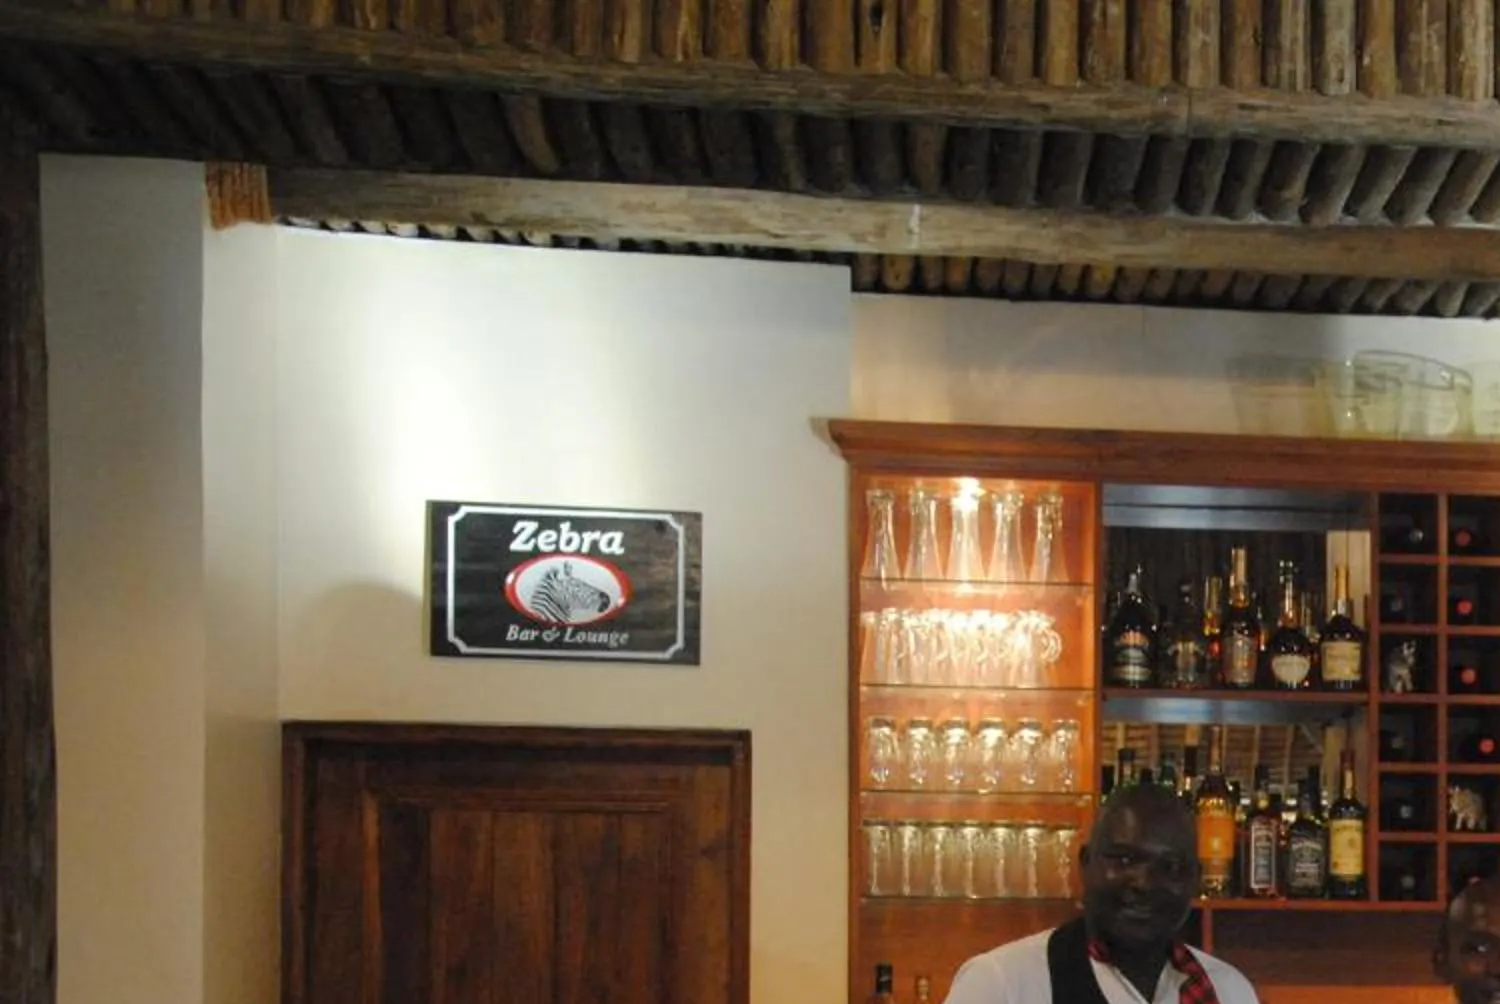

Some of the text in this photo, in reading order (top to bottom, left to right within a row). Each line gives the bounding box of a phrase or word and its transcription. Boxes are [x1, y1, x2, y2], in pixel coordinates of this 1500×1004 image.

[509, 520, 625, 554] Zebra
[506, 624, 630, 648] Bar & Lounge
